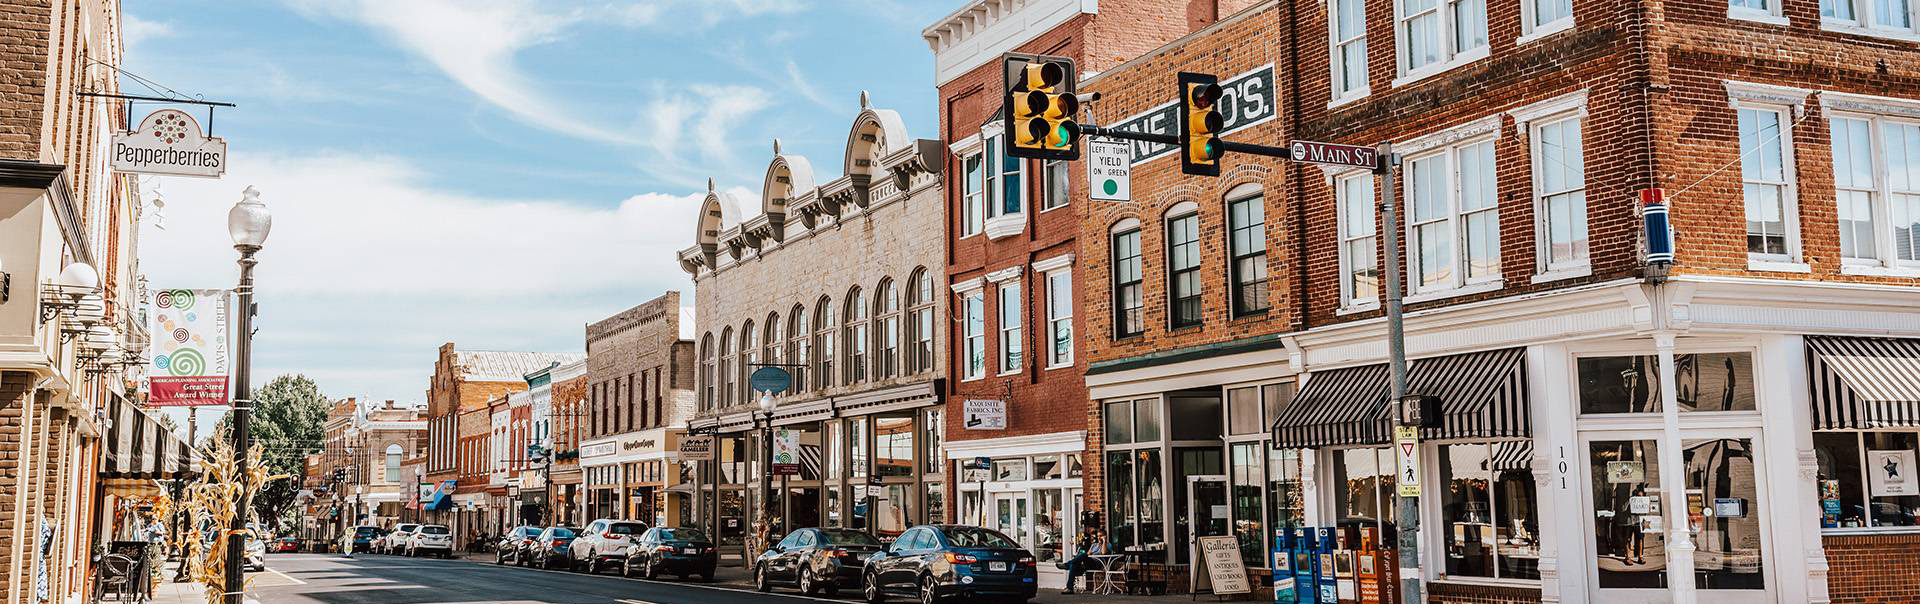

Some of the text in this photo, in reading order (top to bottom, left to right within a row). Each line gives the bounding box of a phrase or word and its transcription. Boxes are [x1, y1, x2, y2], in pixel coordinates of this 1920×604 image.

[116, 142, 220, 168] Pepperberries
[1091, 145, 1128, 155] LEFT TURN
[1309, 144, 1373, 166] MAIN ST
[1099, 156, 1122, 167] YIELD
[1093, 167, 1128, 177] ON GREEN
[215, 345, 225, 374] DAVIS
[182, 383, 225, 391] Great Street
[174, 391, 225, 399] Award Winner
[969, 400, 999, 408] EXQUISITE
[1206, 539, 1237, 554] Galleria
[1214, 562, 1240, 570] ANTIQUES
[1223, 583, 1240, 591] FOOD
